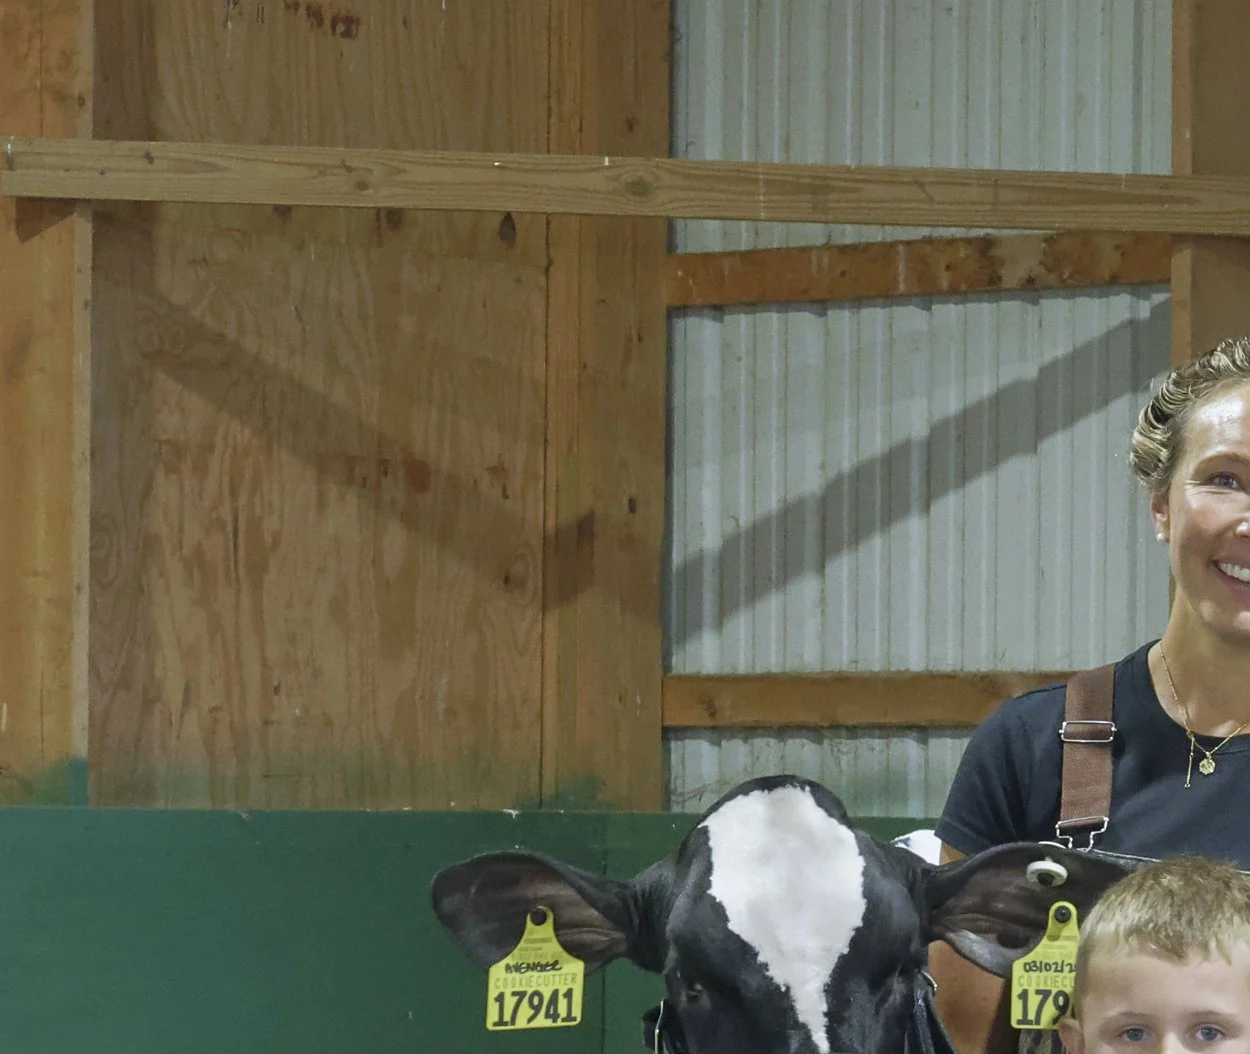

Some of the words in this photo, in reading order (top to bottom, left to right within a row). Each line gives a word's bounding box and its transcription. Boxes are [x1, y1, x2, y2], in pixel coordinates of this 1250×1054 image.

[1023, 960, 1076, 973] 03/02/2
[492, 987, 578, 1027] 17941
[1016, 988, 1070, 1026] 179
